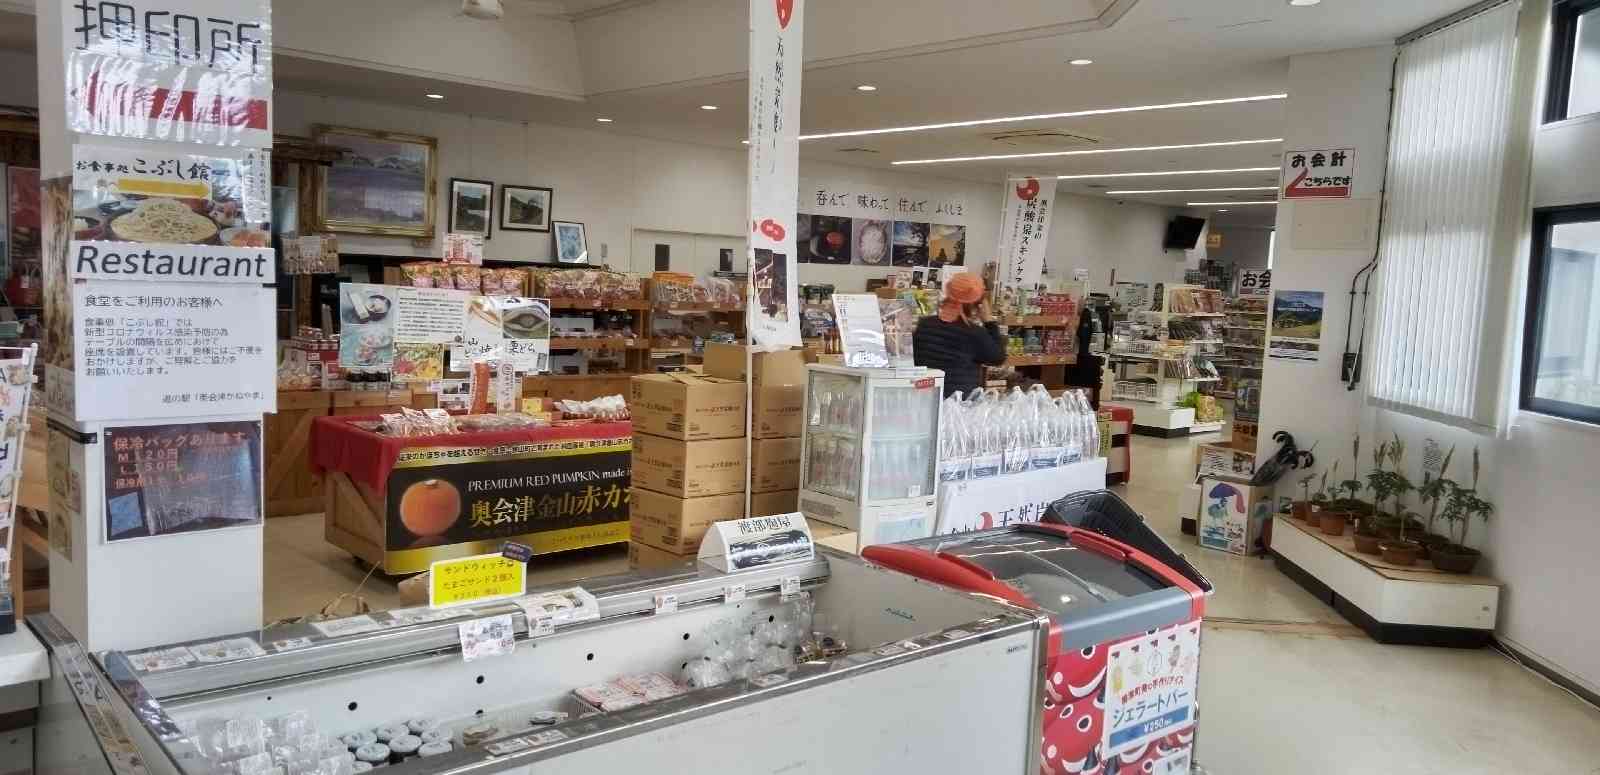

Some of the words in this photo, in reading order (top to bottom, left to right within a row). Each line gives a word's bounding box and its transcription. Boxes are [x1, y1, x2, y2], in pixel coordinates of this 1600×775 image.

[74, 0, 262, 72] 押印所
[76, 159, 130, 174] お食事処
[132, 158, 212, 181] こぶし館
[1291, 150, 1347, 169] お会計
[1304, 174, 1352, 187] こちらです
[76, 245, 267, 278] Restaurant
[84, 295, 223, 309] 食堂をご利用のお客様へ
[468, 476, 523, 492] PREMIUM
[526, 474, 550, 487] RED
[552, 470, 601, 485] PUMPKIN
[602, 468, 625, 480] made
